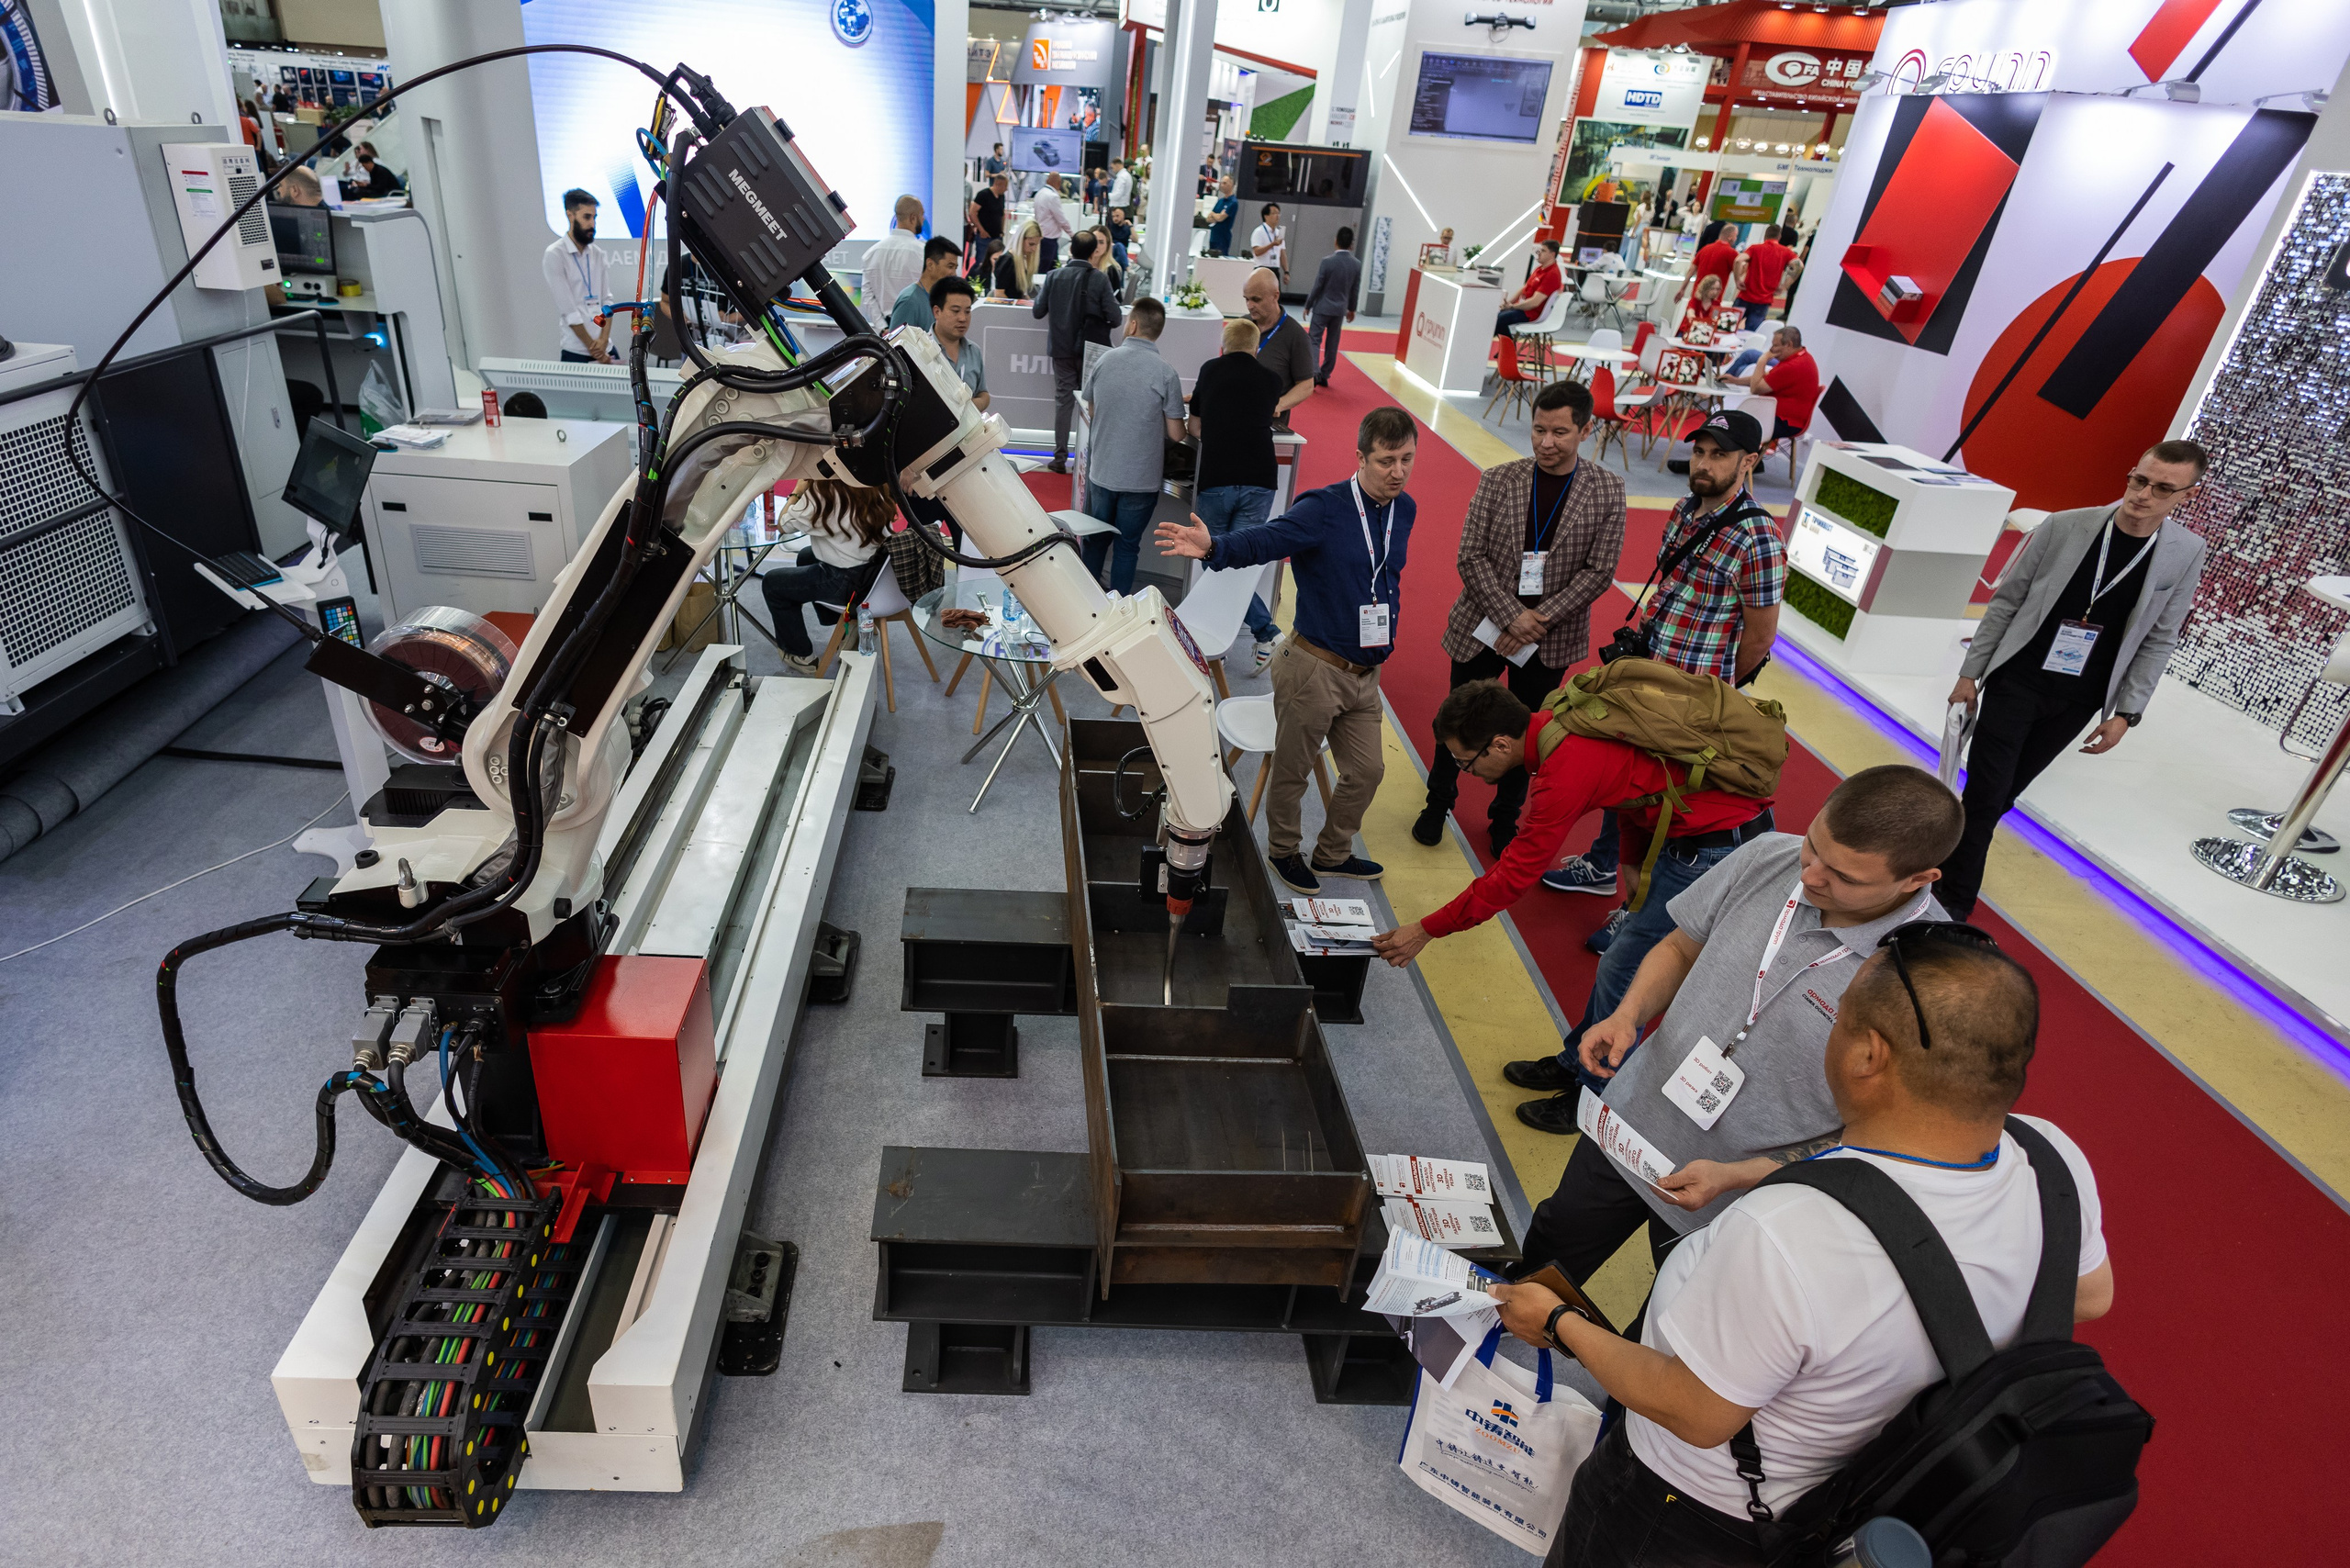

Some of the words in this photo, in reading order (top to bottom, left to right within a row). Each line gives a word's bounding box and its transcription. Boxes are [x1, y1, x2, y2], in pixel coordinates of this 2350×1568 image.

[1820, 78, 1844, 88] CHINA
[1626, 91, 1661, 105] HDTD
[728, 168, 788, 241] MEGMEET
[1698, 530, 1717, 554] SONY
[1617, 1142, 1625, 1156] 3D
[1411, 1160, 1421, 1191] УНИКАЛЬНОЕ
[1428, 1161, 1437, 1193] КОНСТРУКЦИЙ
[1437, 1173, 1444, 1183] 3D
[1415, 1207, 1430, 1239] УНИКАЛЬНОЕ
[1427, 1213, 1438, 1234] МЕТАЛЛО
[1430, 1207, 1445, 1239] КОНСТРУКЦИЙ
[1442, 1218, 1450, 1228] 3D
[1448, 1213, 1459, 1235] ЛАЗЕРНАЯ
[1465, 1408, 1536, 1458] 中铸智能
[1474, 1426, 1521, 1455] ZOOMZU
